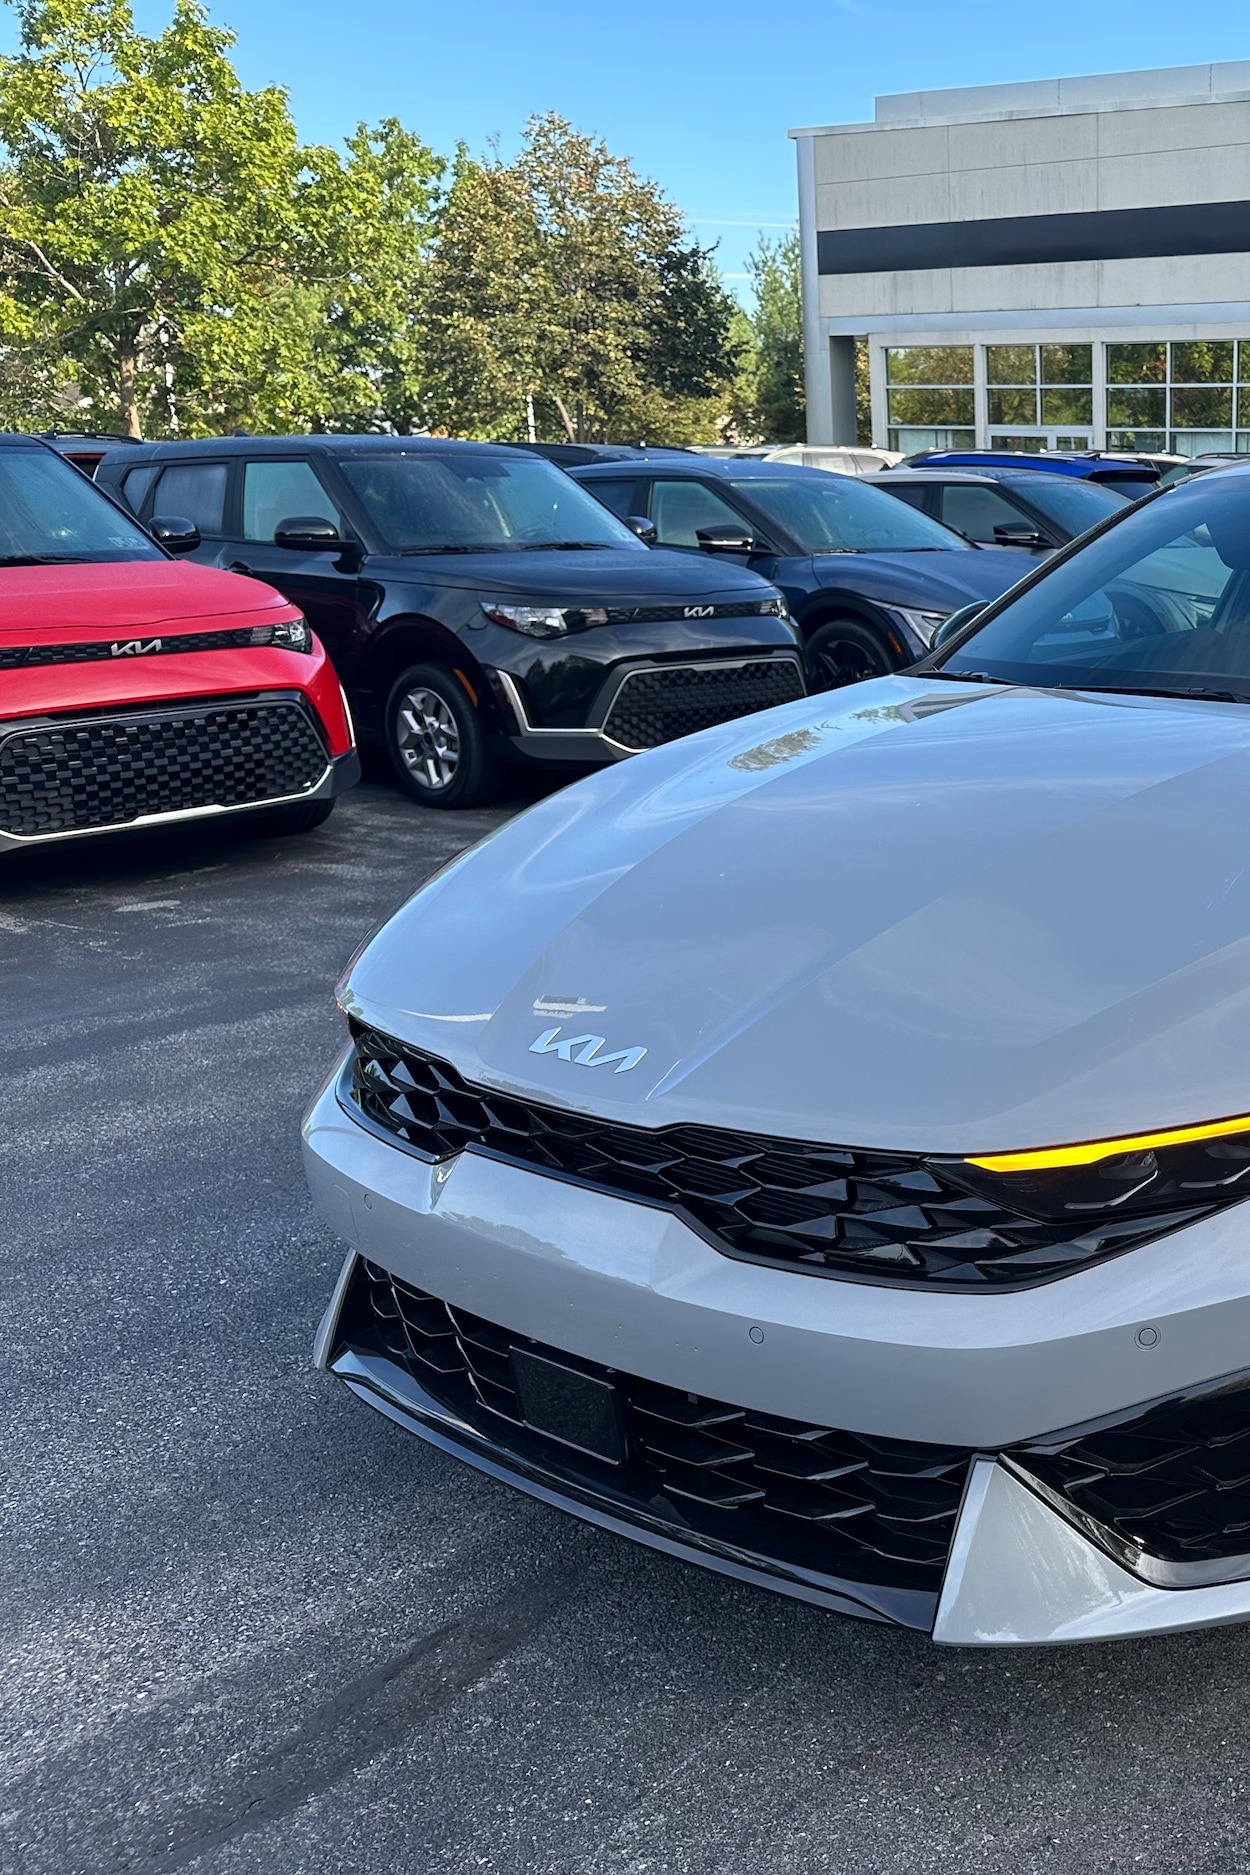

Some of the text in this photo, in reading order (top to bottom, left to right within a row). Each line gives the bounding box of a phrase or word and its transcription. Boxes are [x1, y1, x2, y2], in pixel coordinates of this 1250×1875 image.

[683, 605, 714, 618] KIA
[110, 638, 162, 656] KIA
[528, 1026, 648, 1074] KIA
